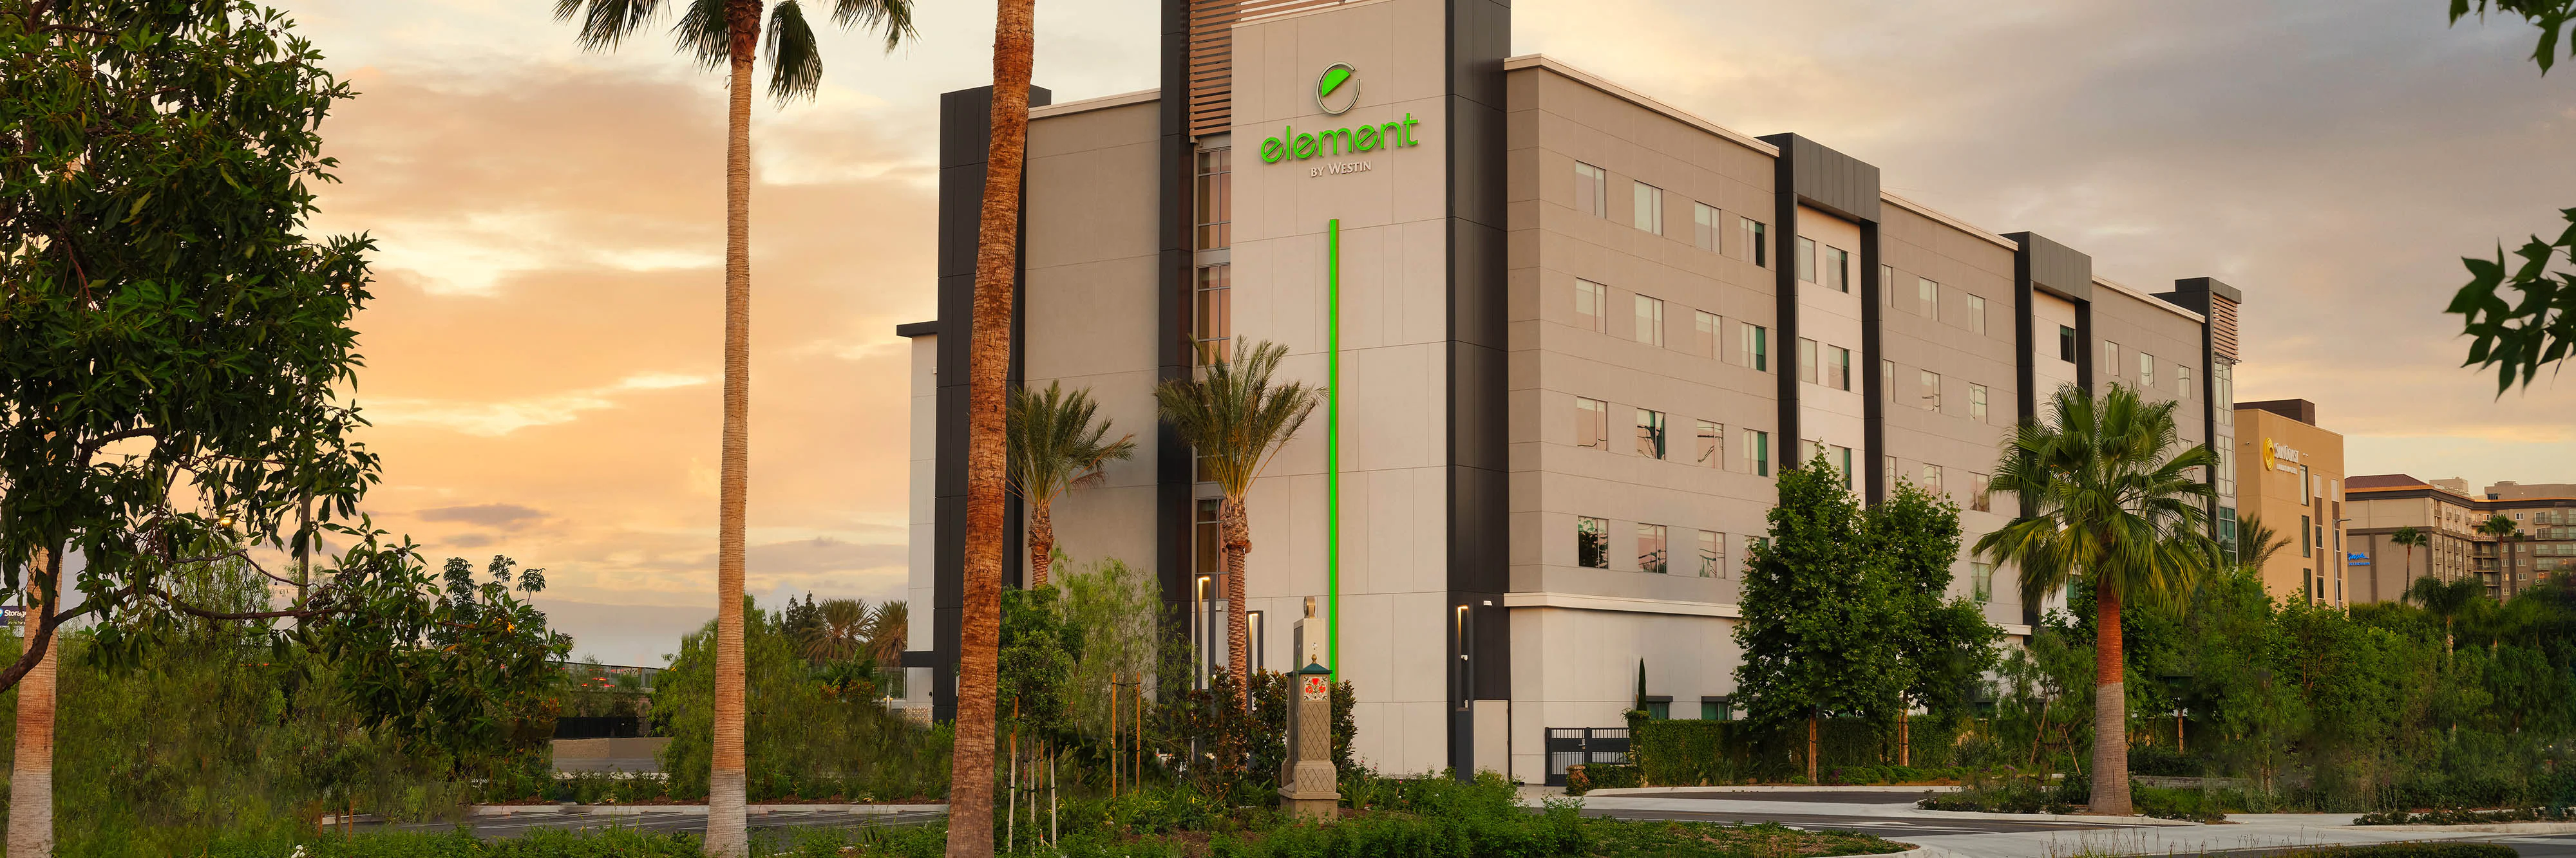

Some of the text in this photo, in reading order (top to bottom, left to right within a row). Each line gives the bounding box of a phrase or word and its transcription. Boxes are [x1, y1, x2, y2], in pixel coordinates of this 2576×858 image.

[1260, 113, 1419, 163] element
[1310, 167, 1324, 177] BY
[5, 610, 26, 618] Storag
